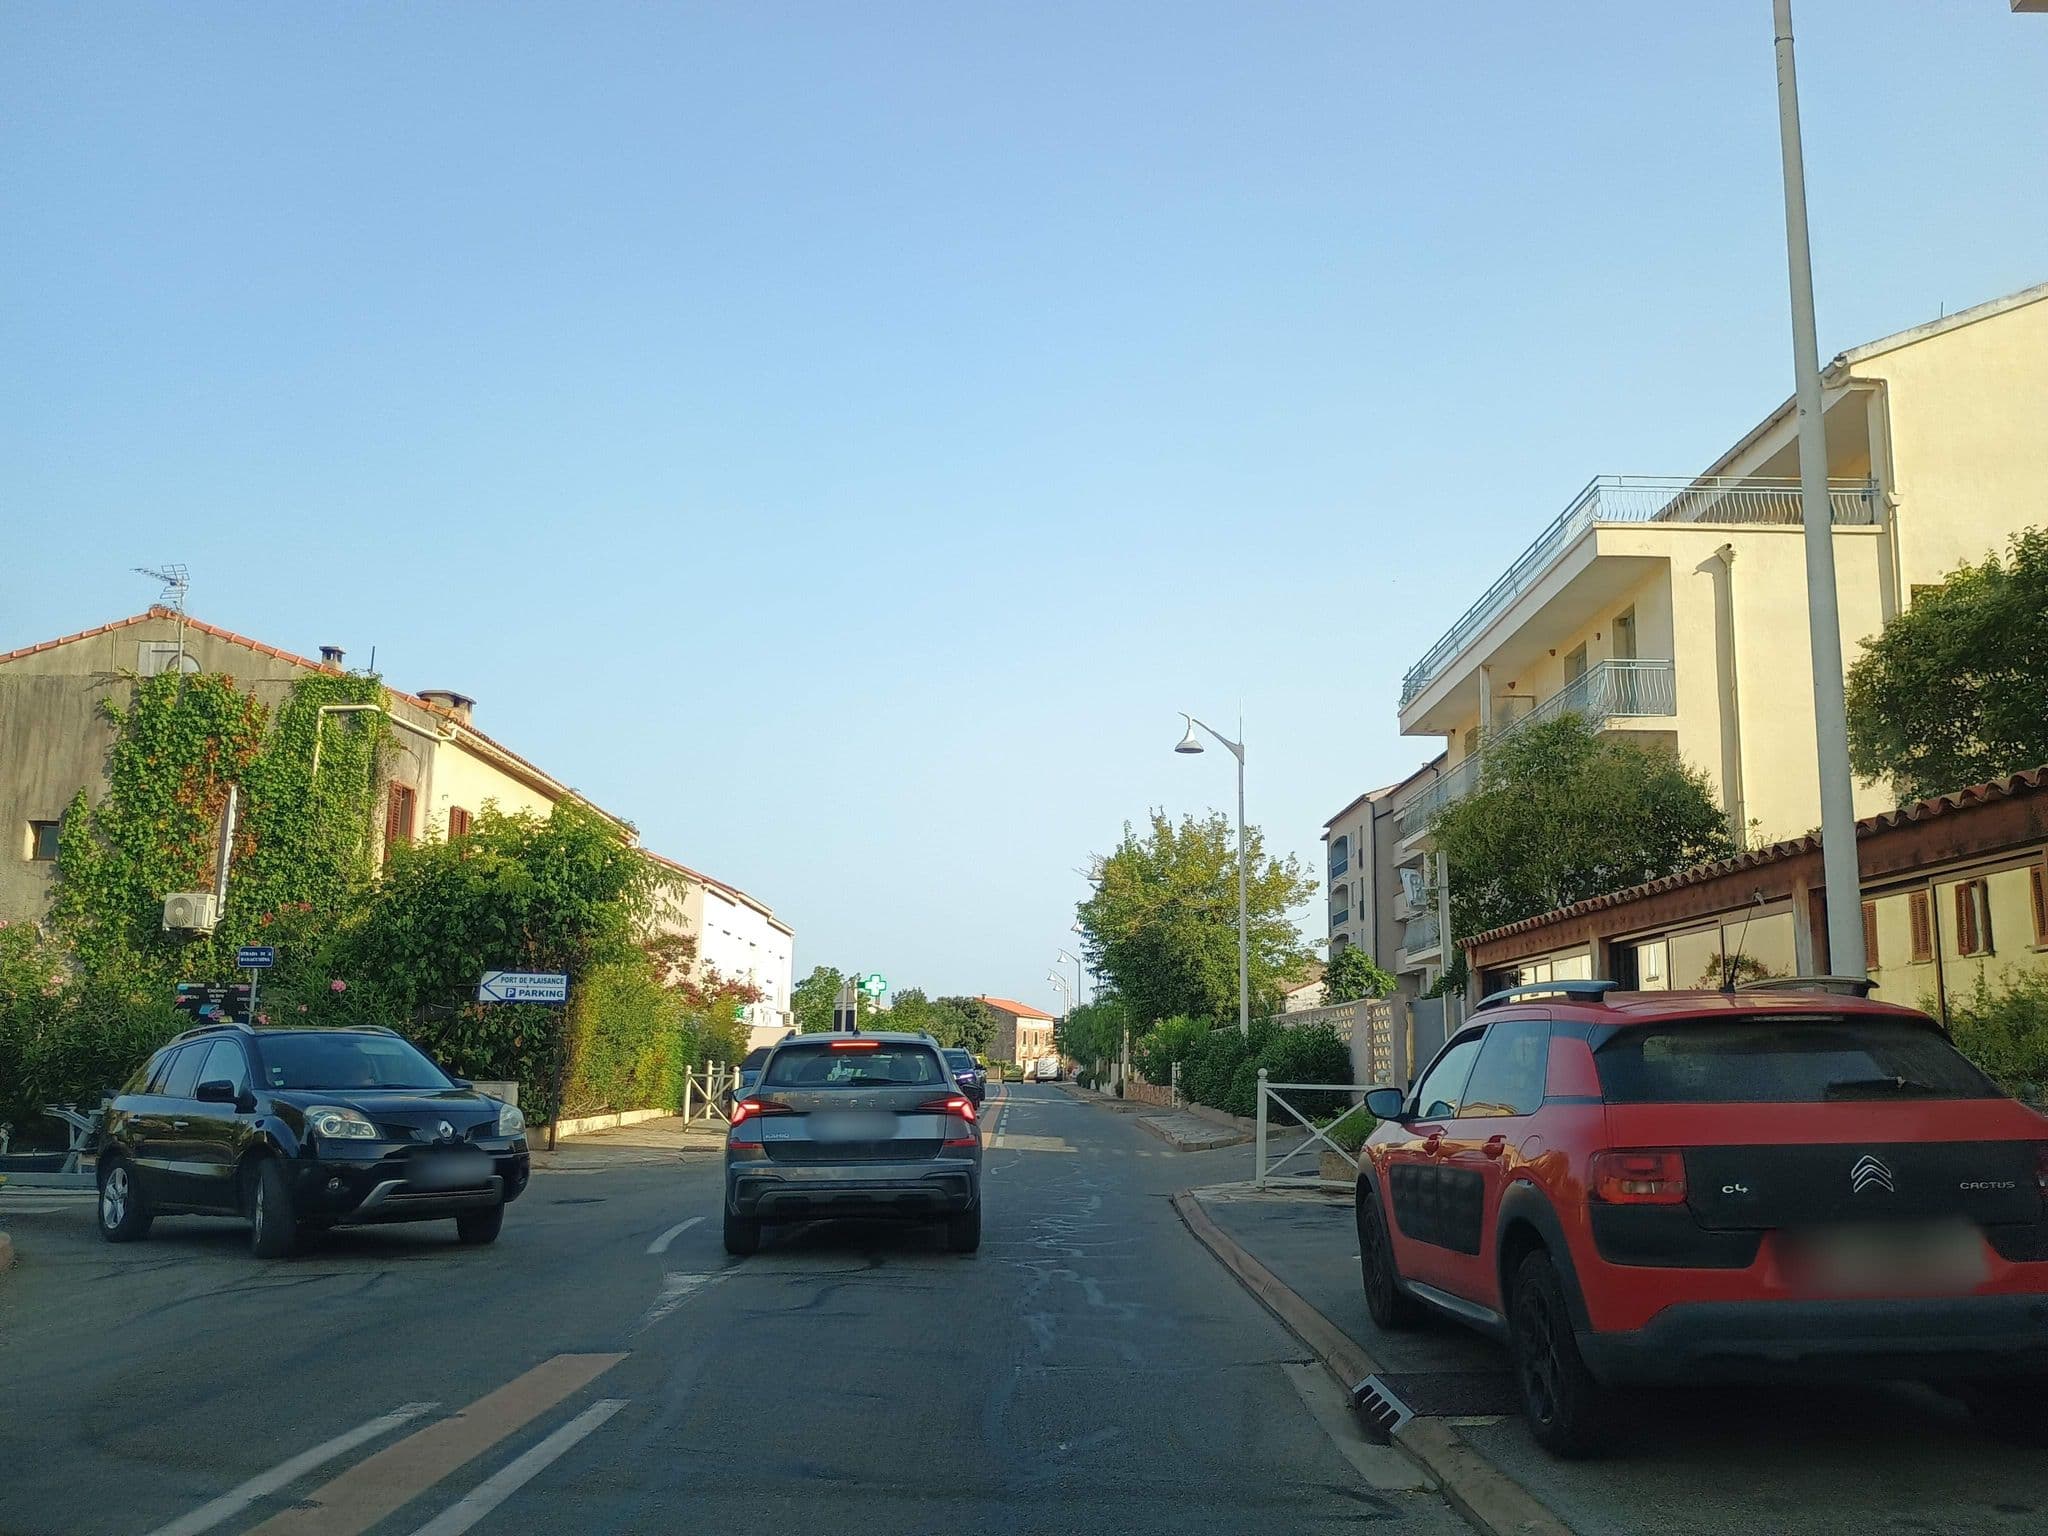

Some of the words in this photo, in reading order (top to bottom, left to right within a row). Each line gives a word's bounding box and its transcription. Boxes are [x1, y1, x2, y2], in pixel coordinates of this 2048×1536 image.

[501, 976, 517, 984] PORT
[528, 977, 564, 985] PLAISANCE
[518, 989, 564, 998] PARKING
[1959, 1181, 2016, 1190] CACTUS
